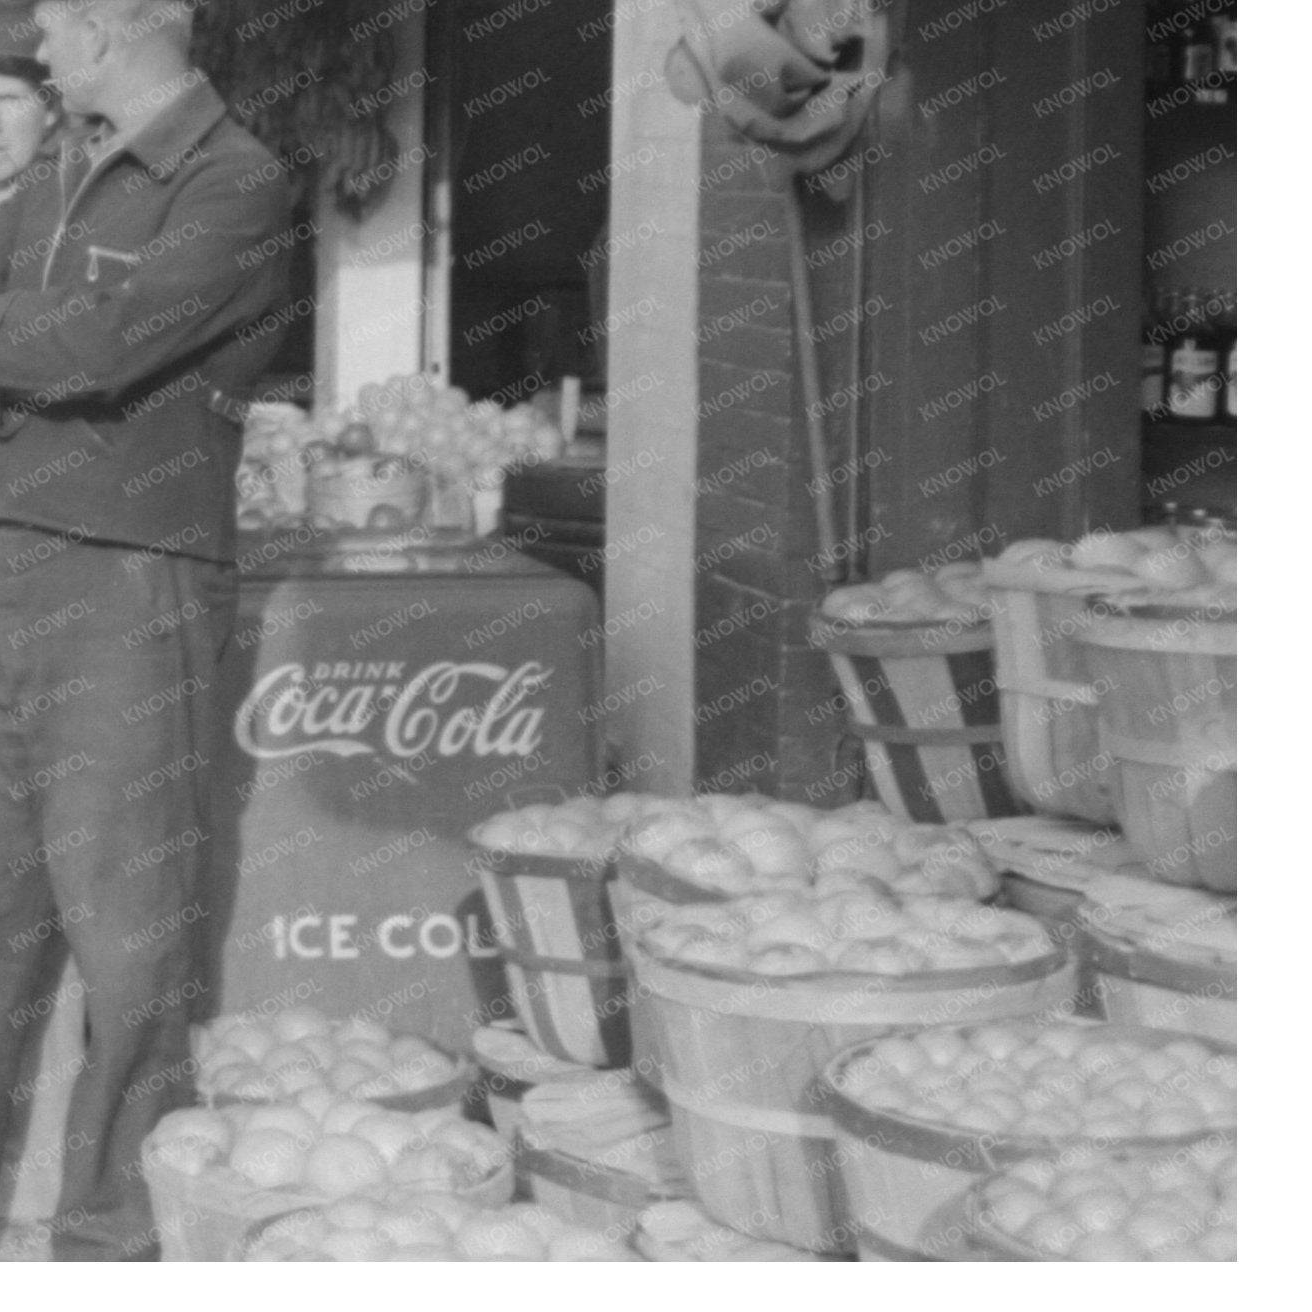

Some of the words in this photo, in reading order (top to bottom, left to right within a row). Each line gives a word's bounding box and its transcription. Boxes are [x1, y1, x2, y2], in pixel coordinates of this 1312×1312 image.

[312, 661, 407, 680] DRINK
[234, 661, 555, 759] Coca-Cola
[274, 914, 360, 959] ICE
[378, 913, 501, 959] COL
